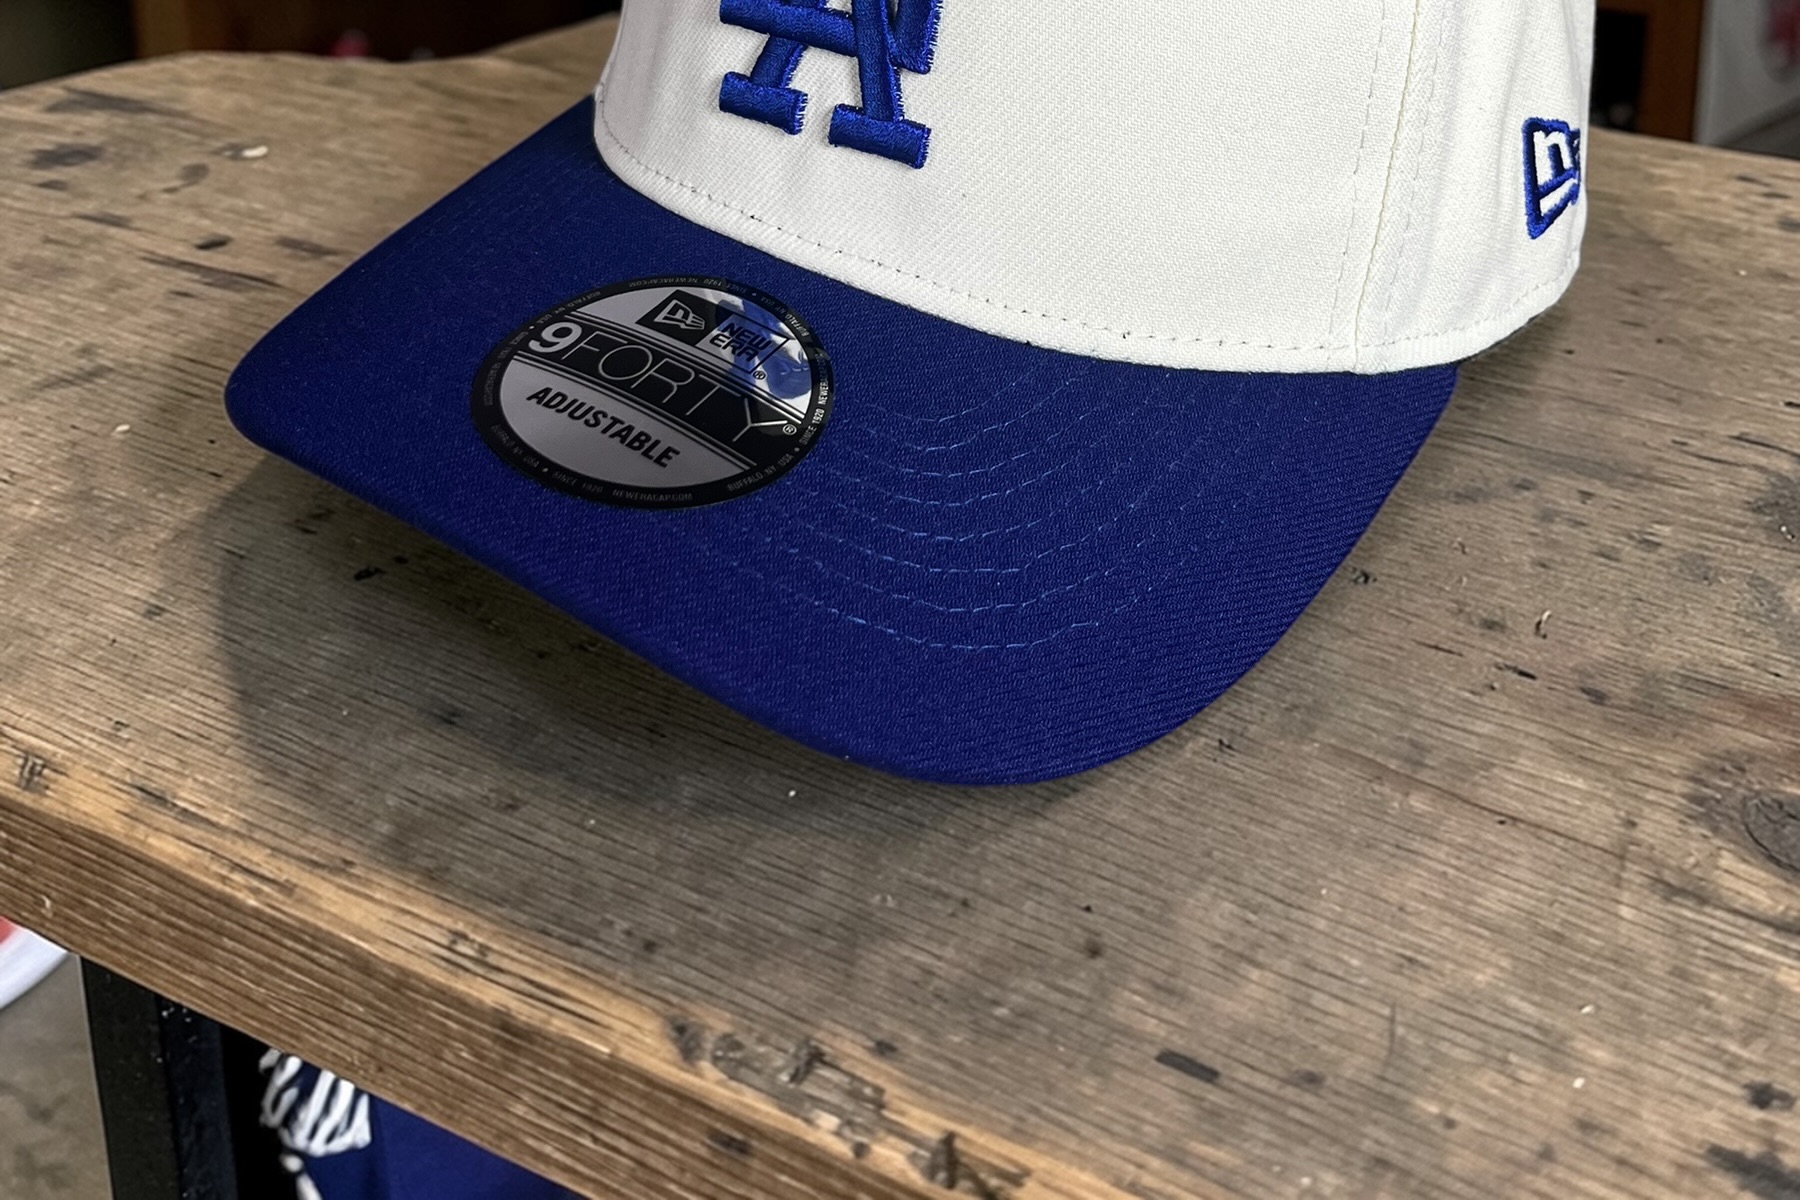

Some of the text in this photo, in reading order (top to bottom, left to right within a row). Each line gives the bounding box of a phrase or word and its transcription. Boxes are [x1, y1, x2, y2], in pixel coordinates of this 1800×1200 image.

[709, 333, 759, 362] ERA
[721, 322, 773, 351] NEW
[526, 387, 681, 469] ADJUSTABLE
[799, 425, 818, 446] SINCE
[811, 408, 826, 425] 1920
[727, 453, 796, 492] BUFFALO NY USA
